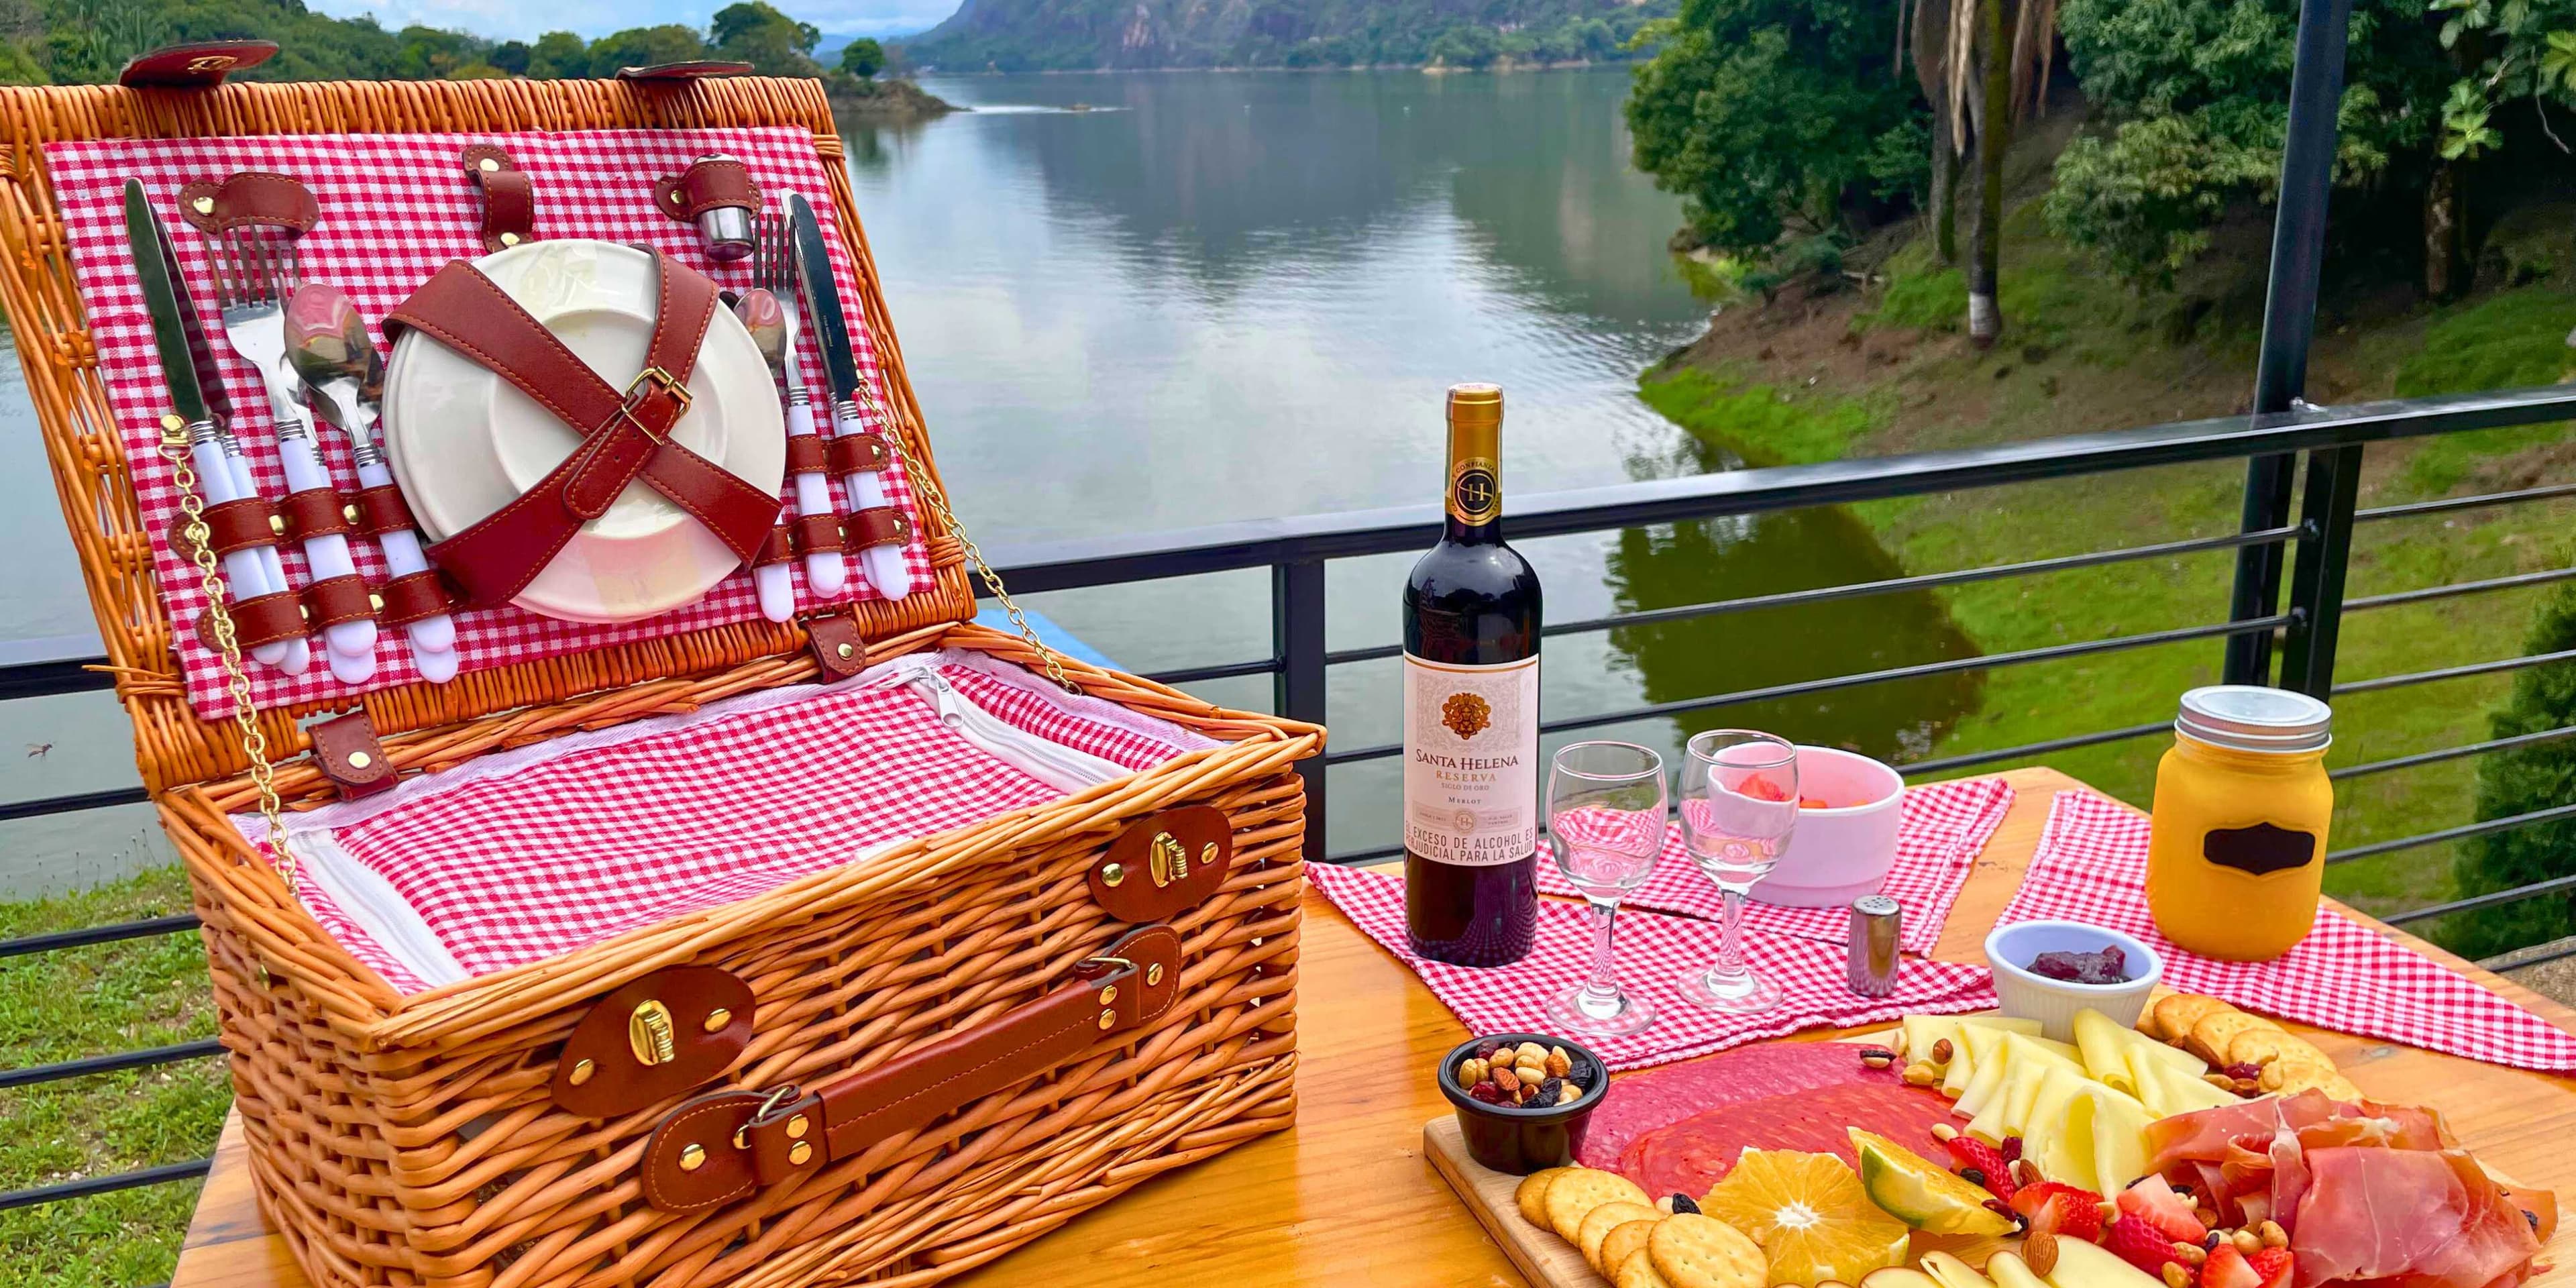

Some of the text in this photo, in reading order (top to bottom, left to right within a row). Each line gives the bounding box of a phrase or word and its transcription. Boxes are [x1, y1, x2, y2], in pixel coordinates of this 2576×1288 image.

[1416, 749, 1519, 770] SANTA HELENA
[1436, 770, 1497, 782] RESERVA
[1442, 783, 1462, 791] SIGLO
[1413, 826, 1446, 847] EXCESO
[1454, 838, 1468, 849] DE
[1474, 832, 1521, 849] ALCOHOL
[1526, 827, 1533, 841] ES
[1460, 850, 1489, 862] PARA
[1493, 850, 1505, 861] LA
[1509, 840, 1533, 858] SALUD
